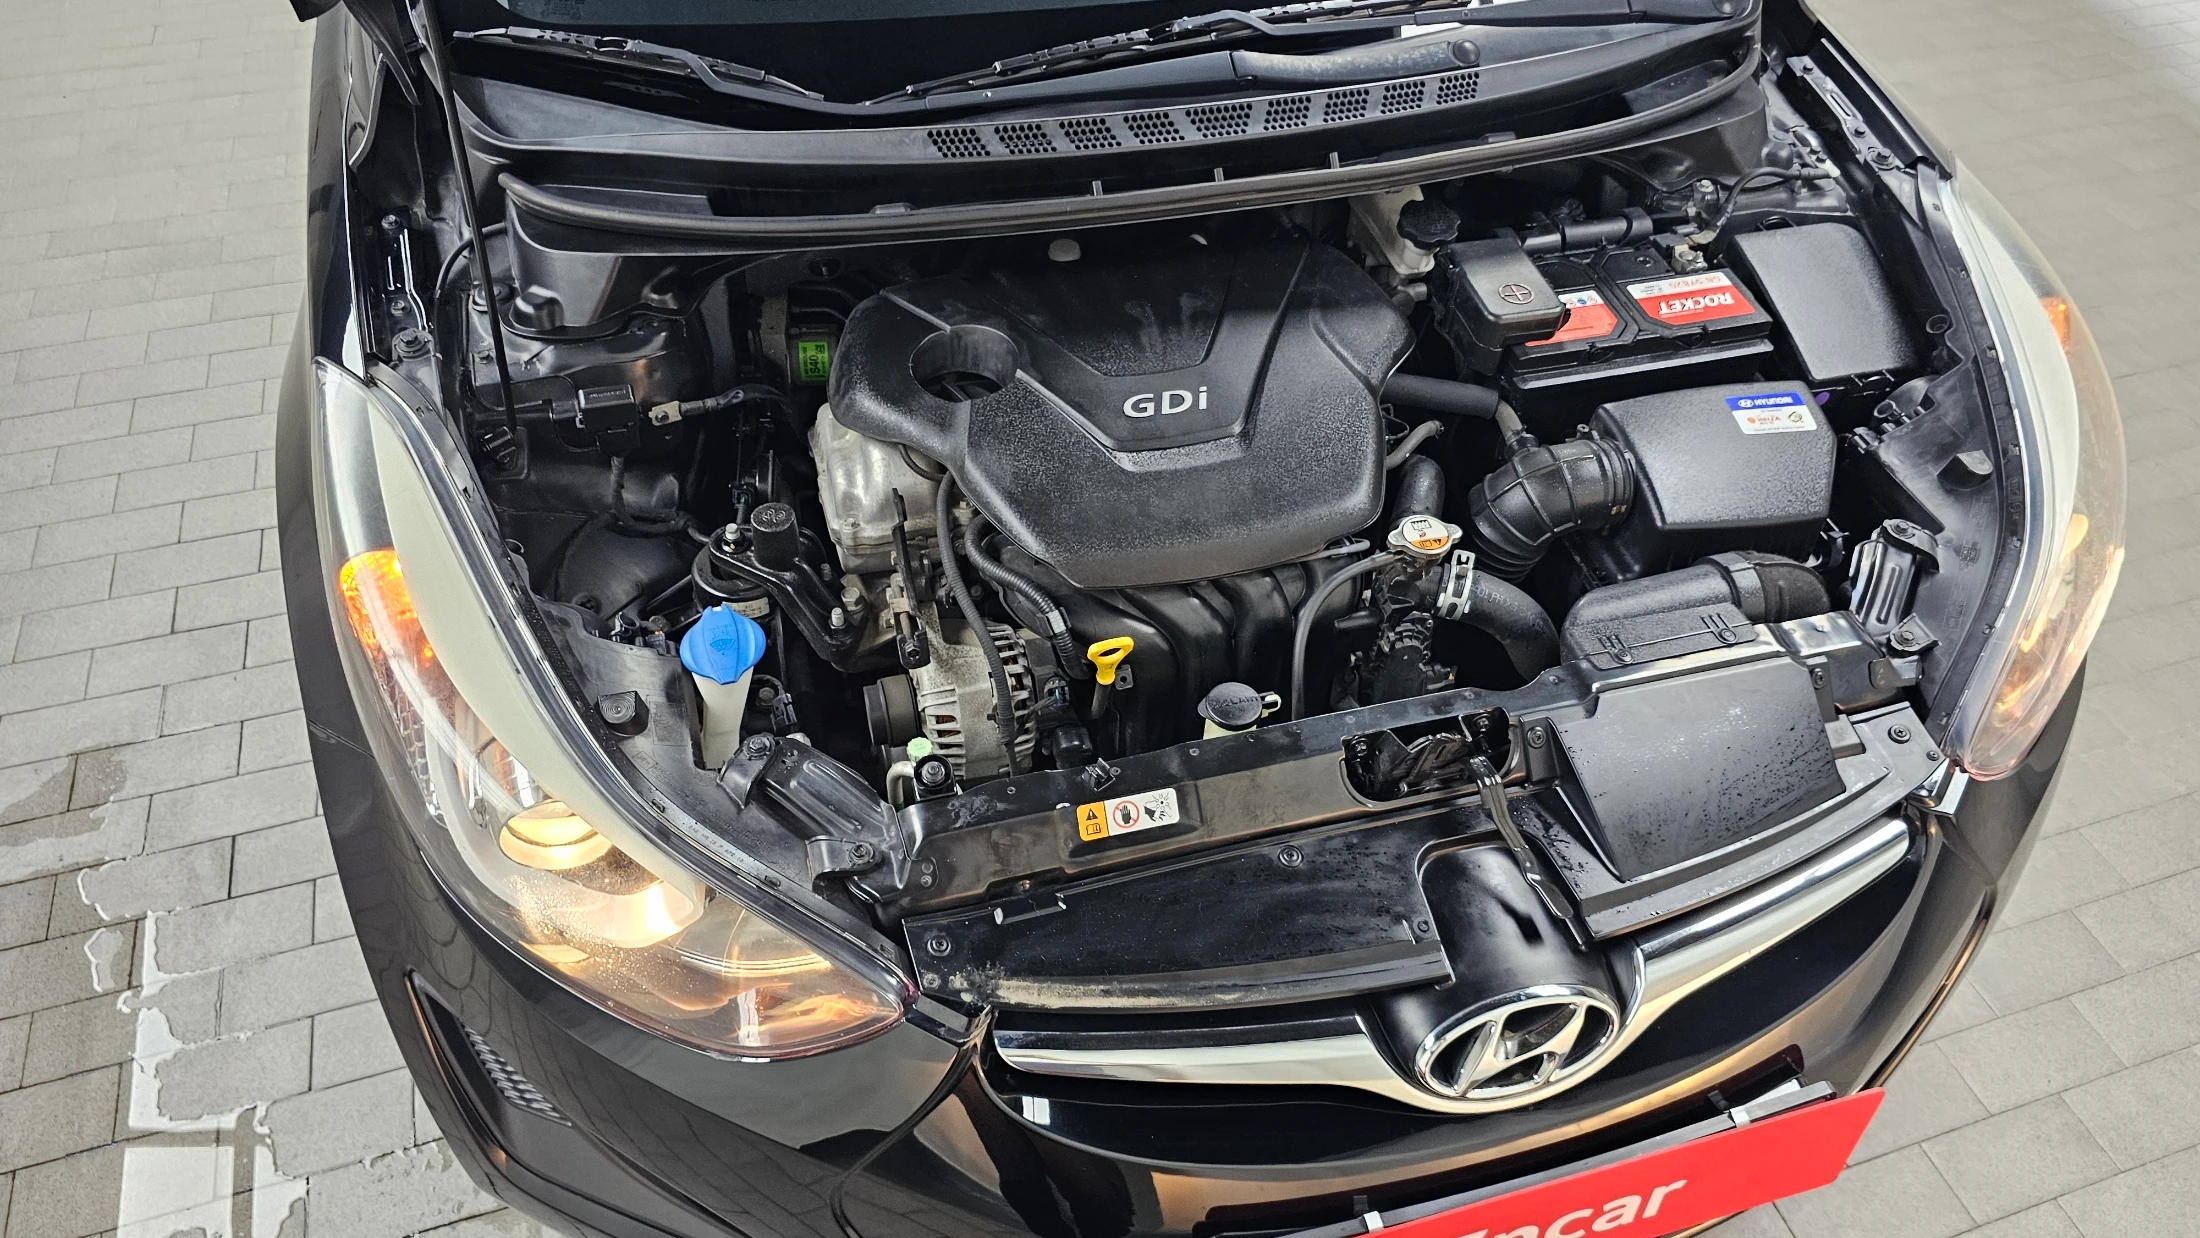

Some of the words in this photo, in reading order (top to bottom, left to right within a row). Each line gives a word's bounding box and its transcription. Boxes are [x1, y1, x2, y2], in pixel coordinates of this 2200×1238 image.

[1658, 292, 1735, 315] ROCKET
[1123, 386, 1207, 418] GDi
[1754, 396, 1794, 406] HYUNDAI
[1457, 1179, 1688, 1238] car
